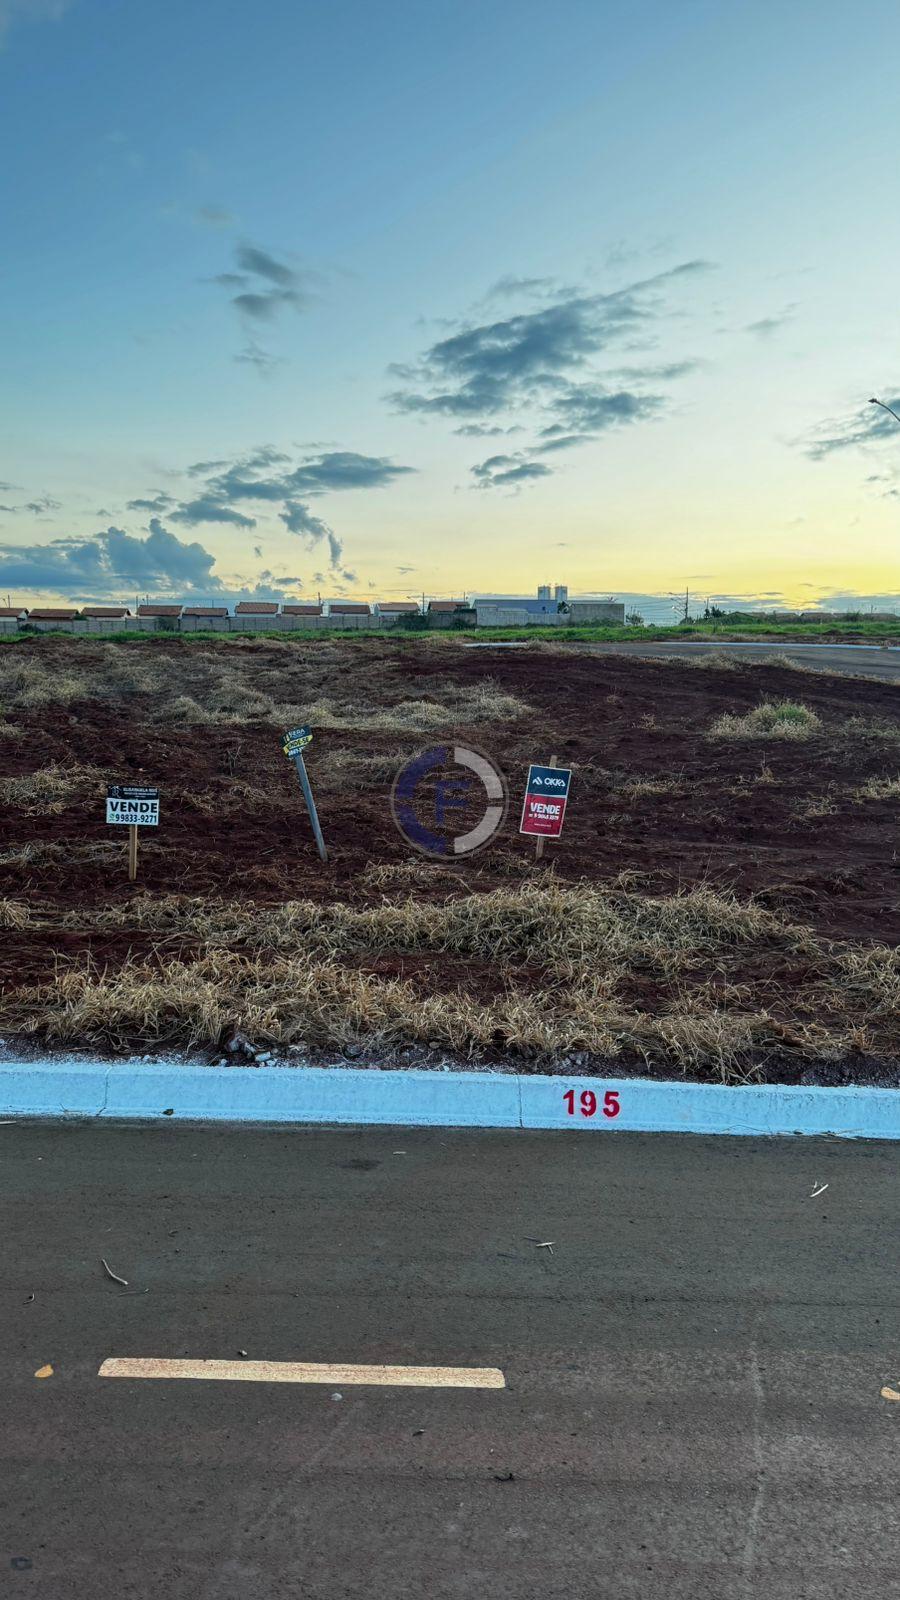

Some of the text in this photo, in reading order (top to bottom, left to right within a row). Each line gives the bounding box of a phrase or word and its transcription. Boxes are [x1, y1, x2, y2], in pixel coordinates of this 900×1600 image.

[110, 801, 157, 813] VENDE
[530, 802, 561, 814] VENDE
[563, 1089, 621, 1118] 195
